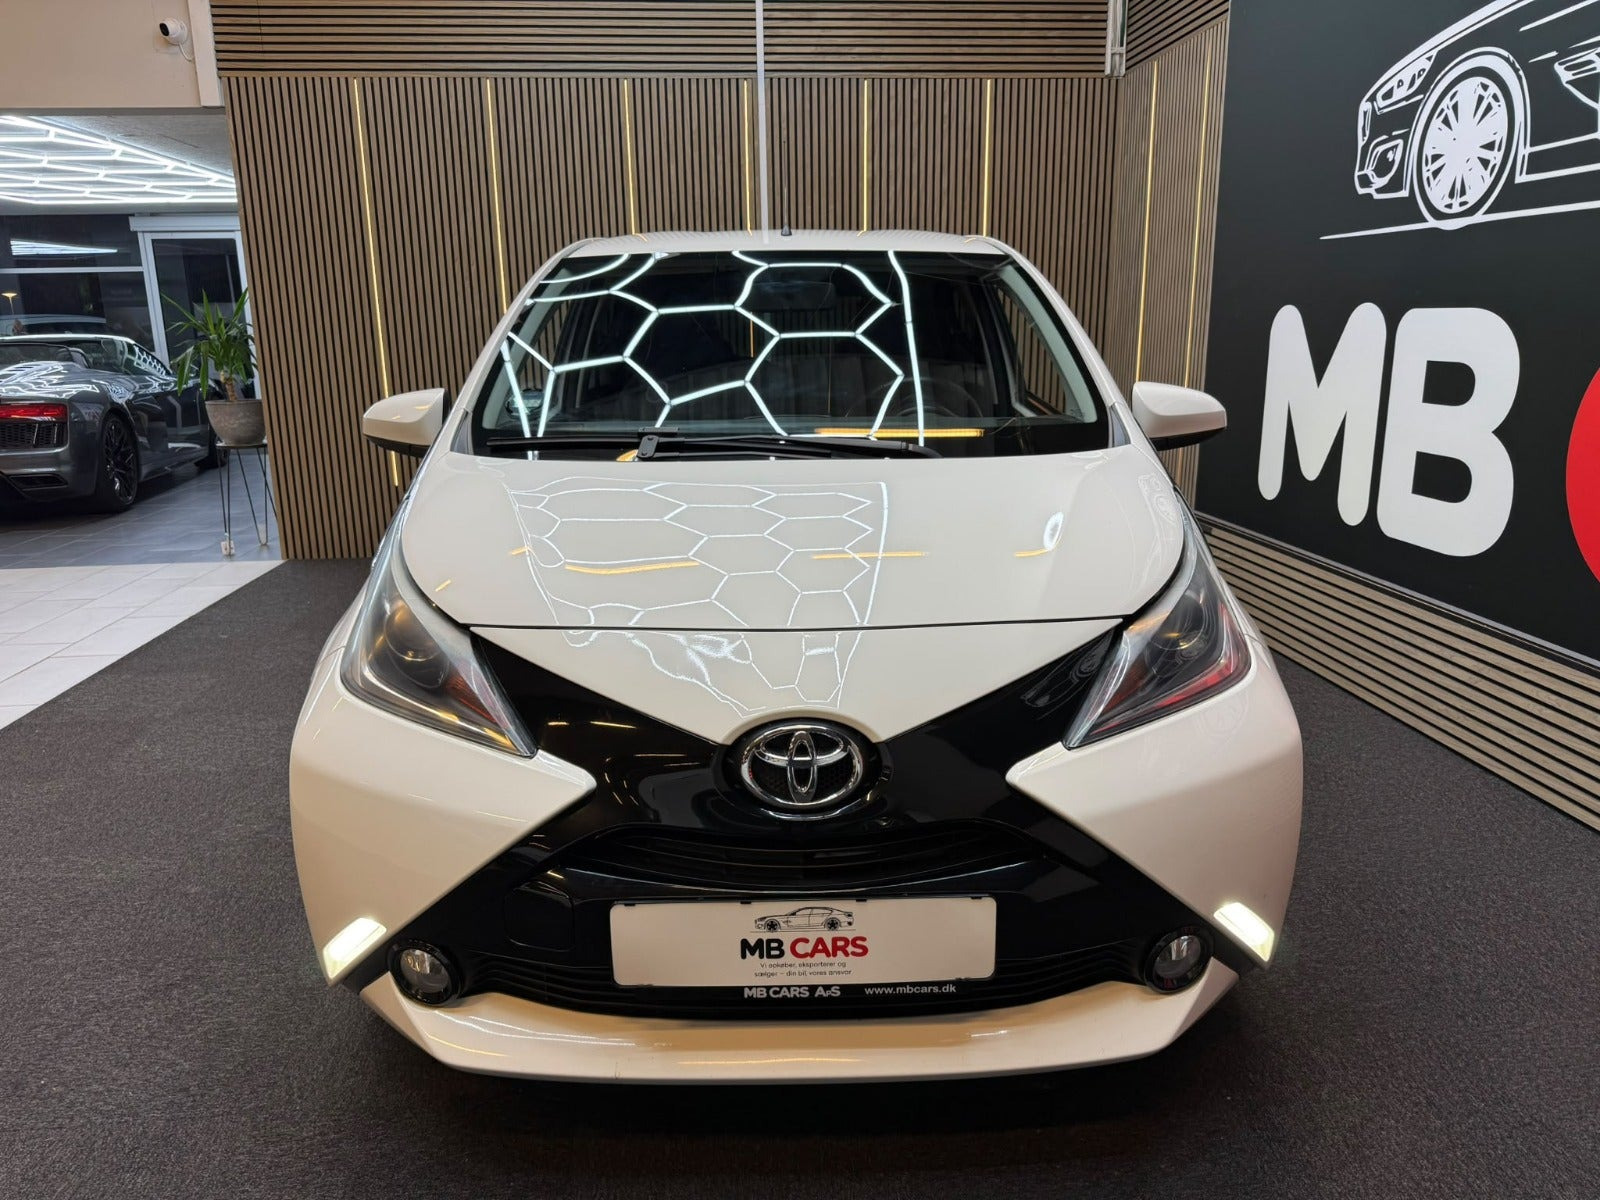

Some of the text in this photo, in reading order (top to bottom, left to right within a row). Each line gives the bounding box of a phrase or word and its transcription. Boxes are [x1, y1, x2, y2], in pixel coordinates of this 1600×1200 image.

[1258, 302, 1521, 557] MB
[740, 936, 869, 960] MB CARS
[837, 961, 847, 969] og
[828, 969, 852, 977] ansvar
[743, 987, 767, 999] MB
[769, 986, 809, 999] CARS
[864, 984, 957, 995] www.mbcars.dk
